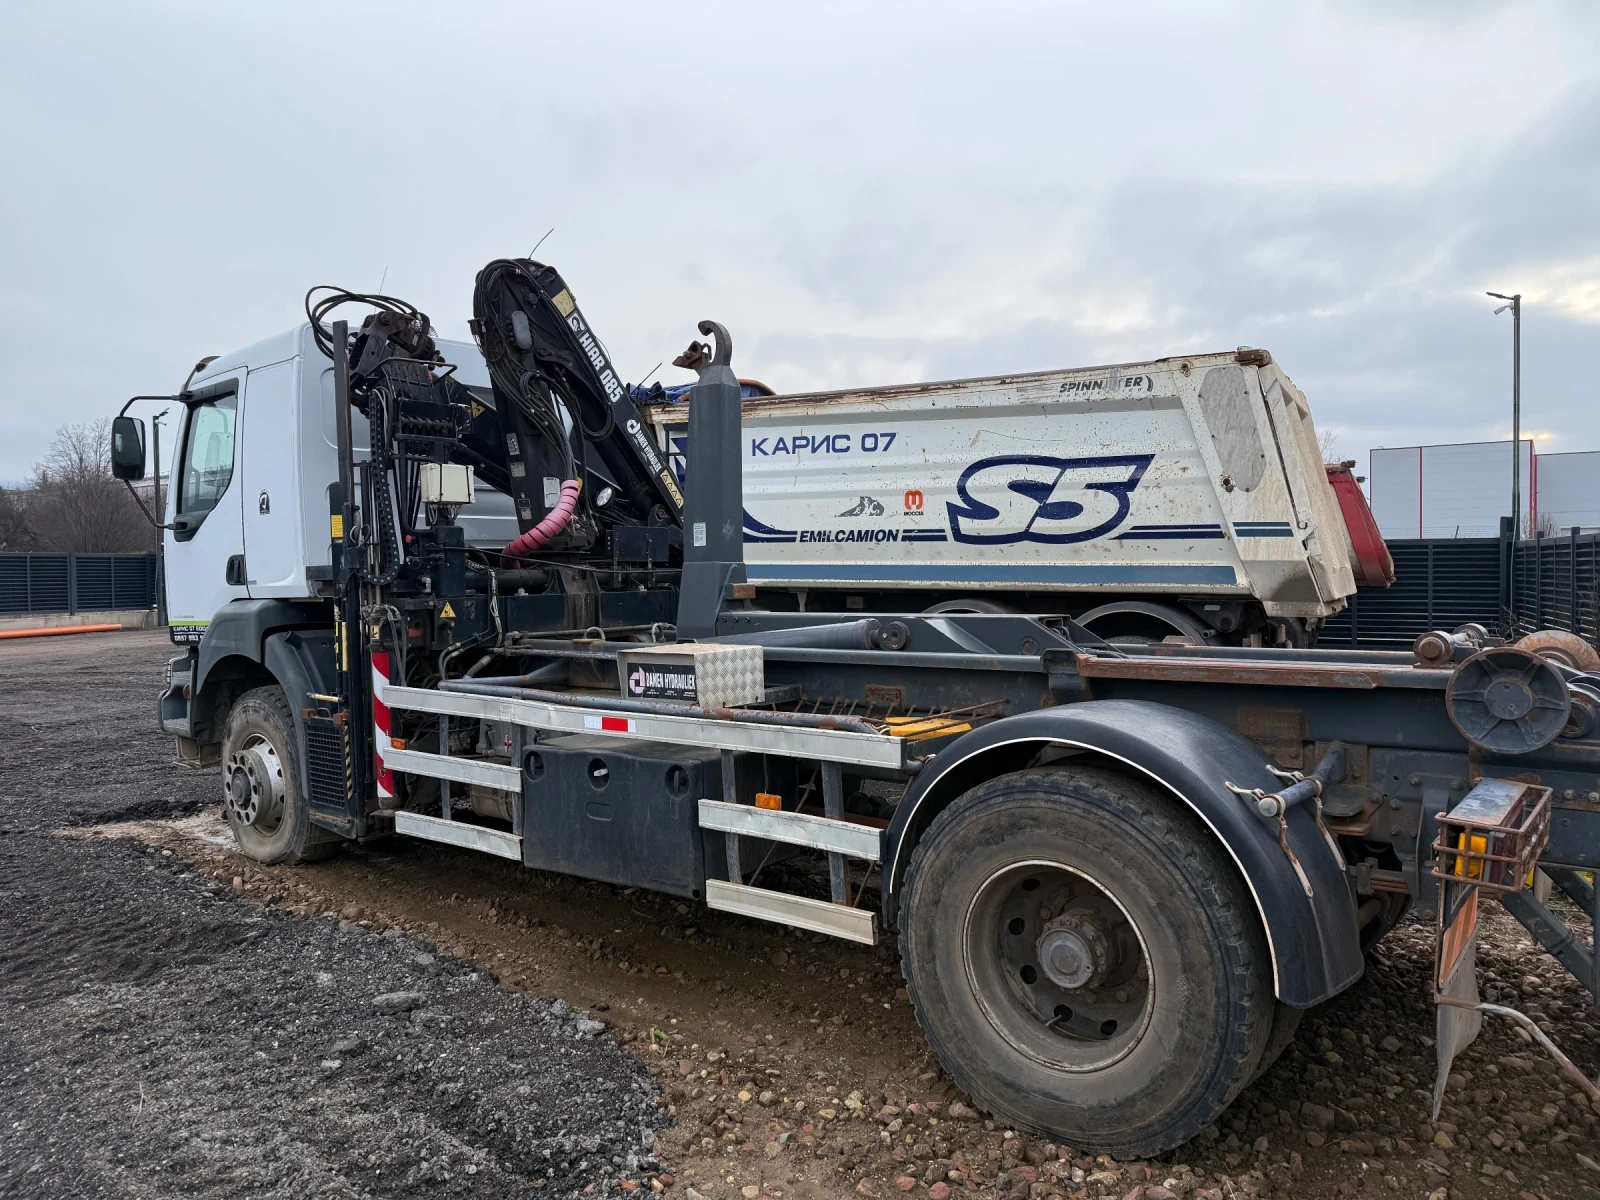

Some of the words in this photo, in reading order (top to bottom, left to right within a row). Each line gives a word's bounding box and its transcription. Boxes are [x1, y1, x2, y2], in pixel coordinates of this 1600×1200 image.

[600, 369, 624, 403] 085
[752, 434, 851, 457] КАРИС
[861, 432, 897, 453] 07
[946, 453, 1156, 546] S5
[799, 529, 899, 543] EMILCAMION
[646, 672, 664, 687] DAMEN
[664, 673, 696, 690] HYDRAULIEK
